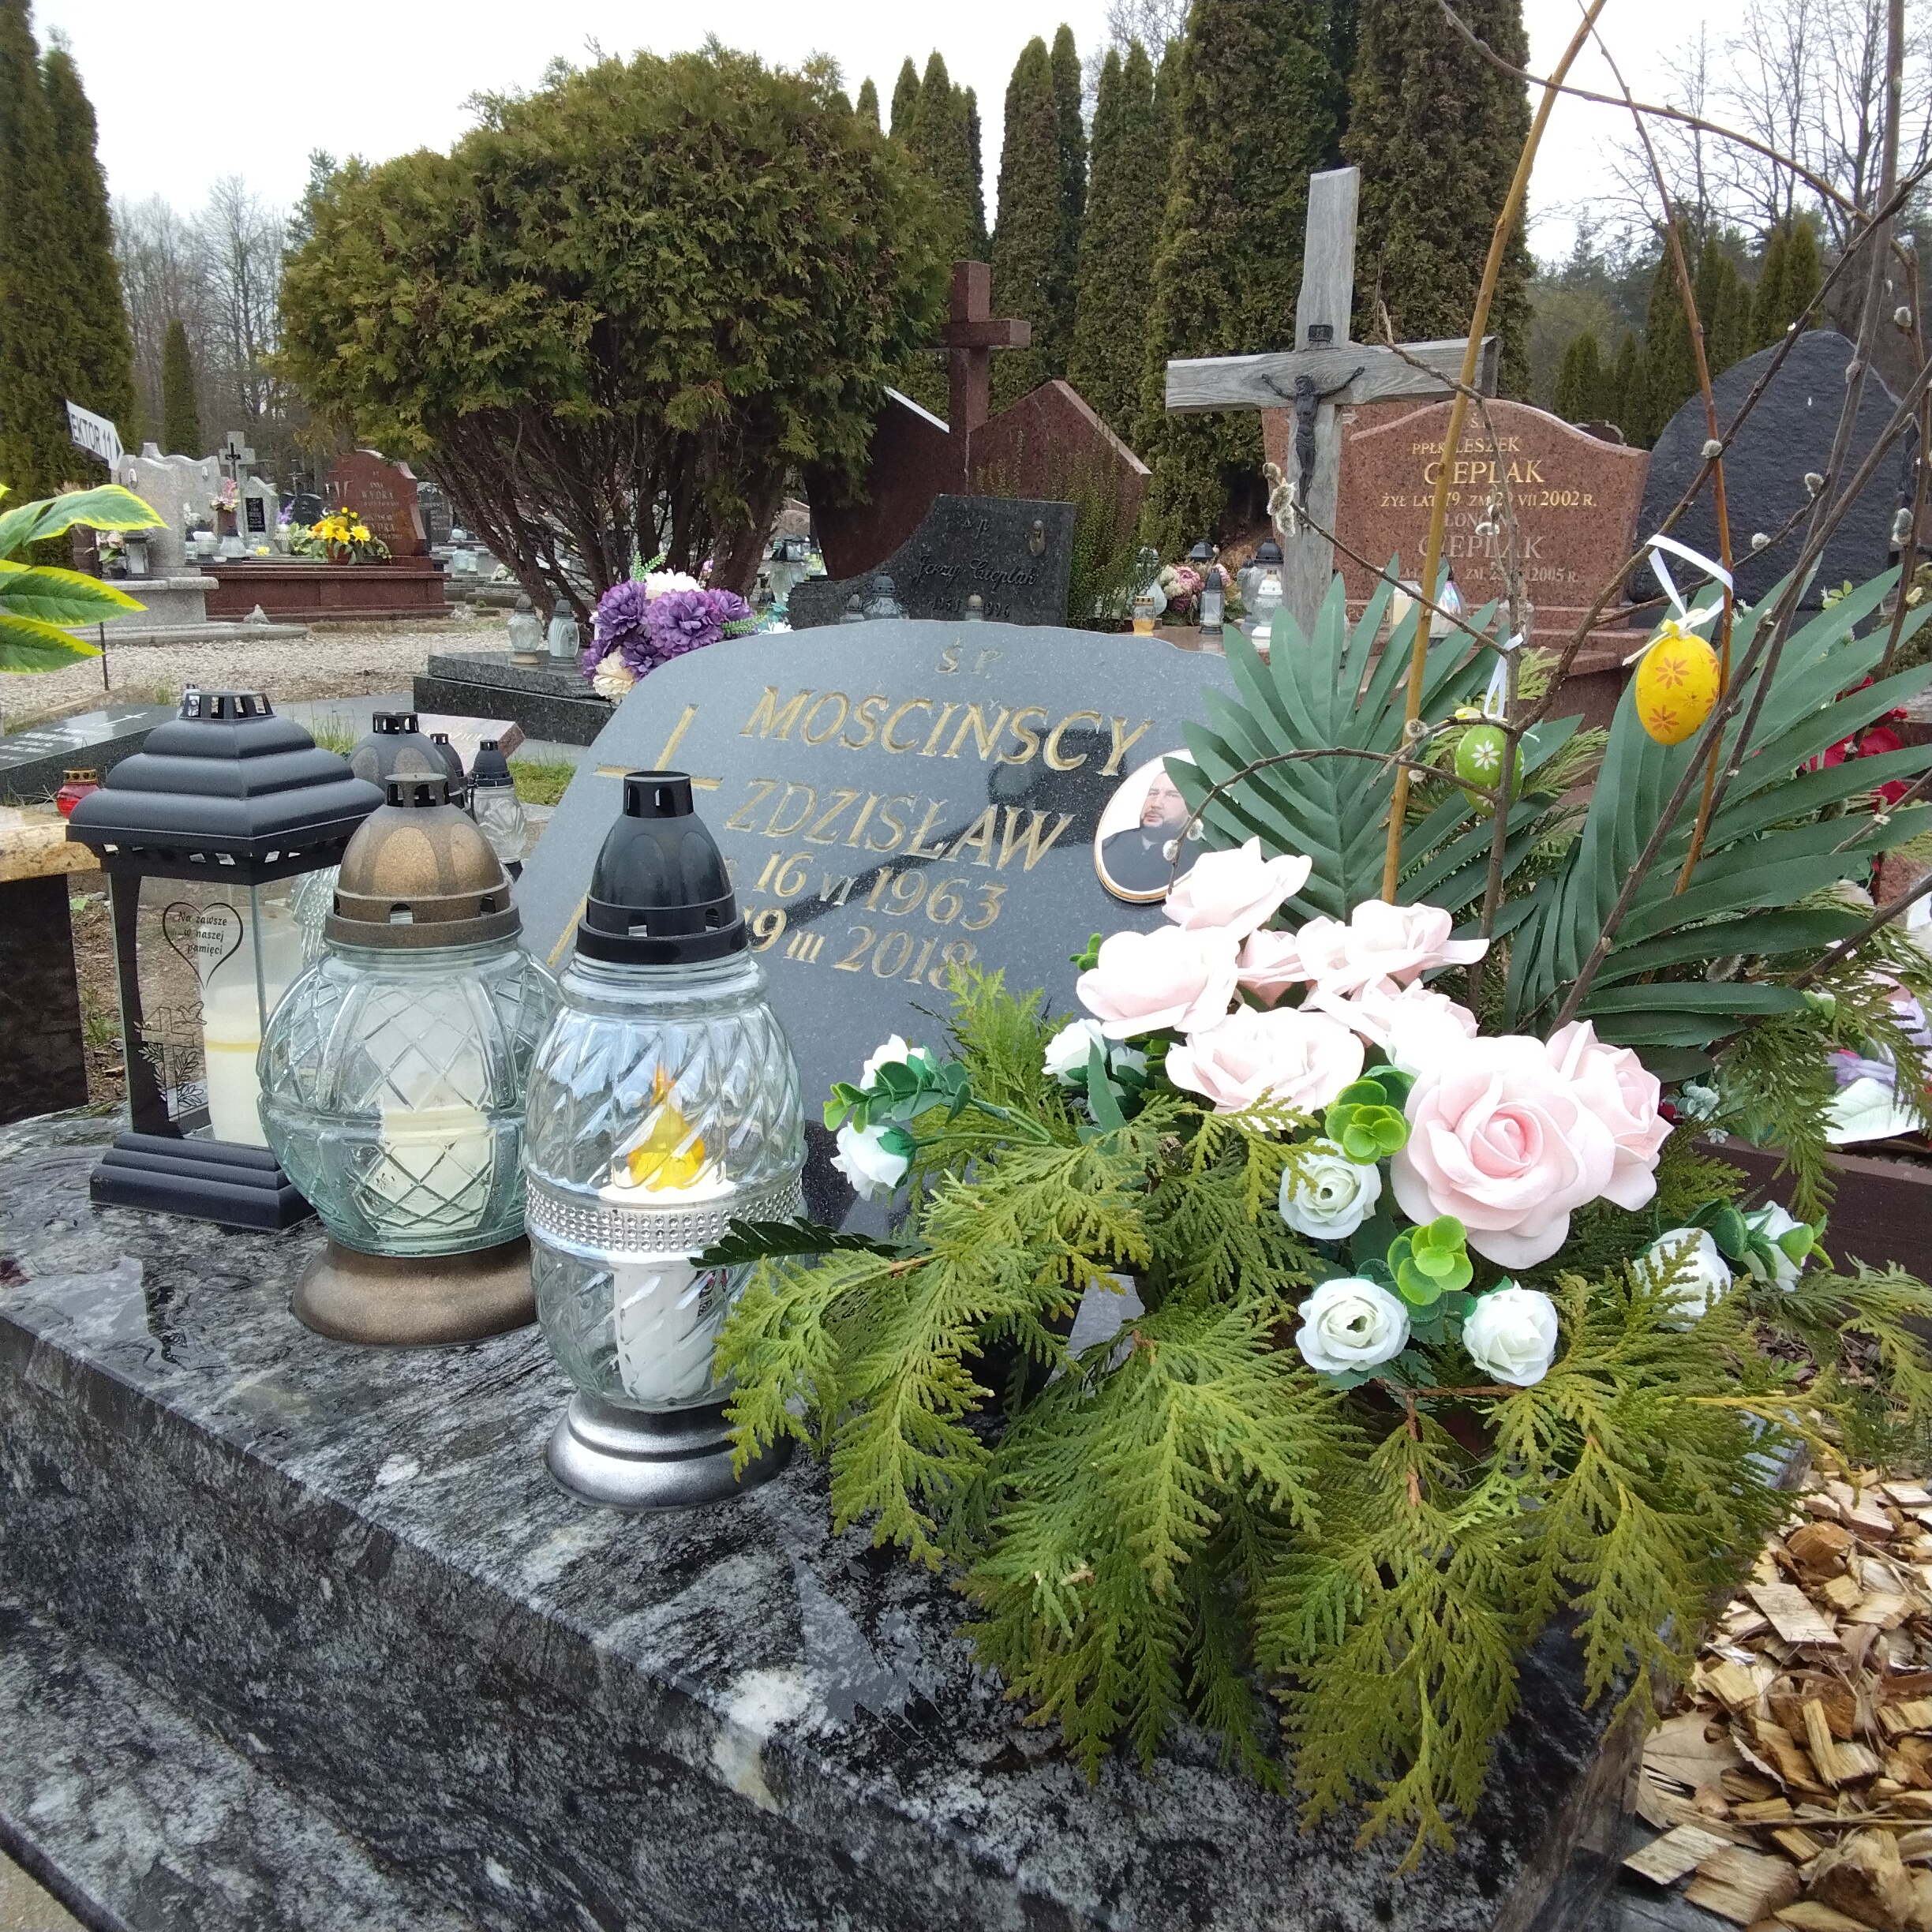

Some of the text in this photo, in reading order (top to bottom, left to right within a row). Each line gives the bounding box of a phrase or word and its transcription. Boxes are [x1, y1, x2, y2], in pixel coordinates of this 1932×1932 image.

[70, 414, 102, 455] EKTOR
[1424, 459, 1545, 485] CEPLAK
[1540, 489, 1580, 507] 2002
[1418, 534, 1544, 559] CEPLK
[724, 777, 1078, 872] ZDZISŁAW
[753, 851, 815, 898] 16
[862, 865, 1008, 931] 1963
[196, 915, 228, 927] zawsze
[196, 930, 225, 943] naszej
[187, 943, 223, 957] pamięci
[831, 925, 978, 991] 2018
